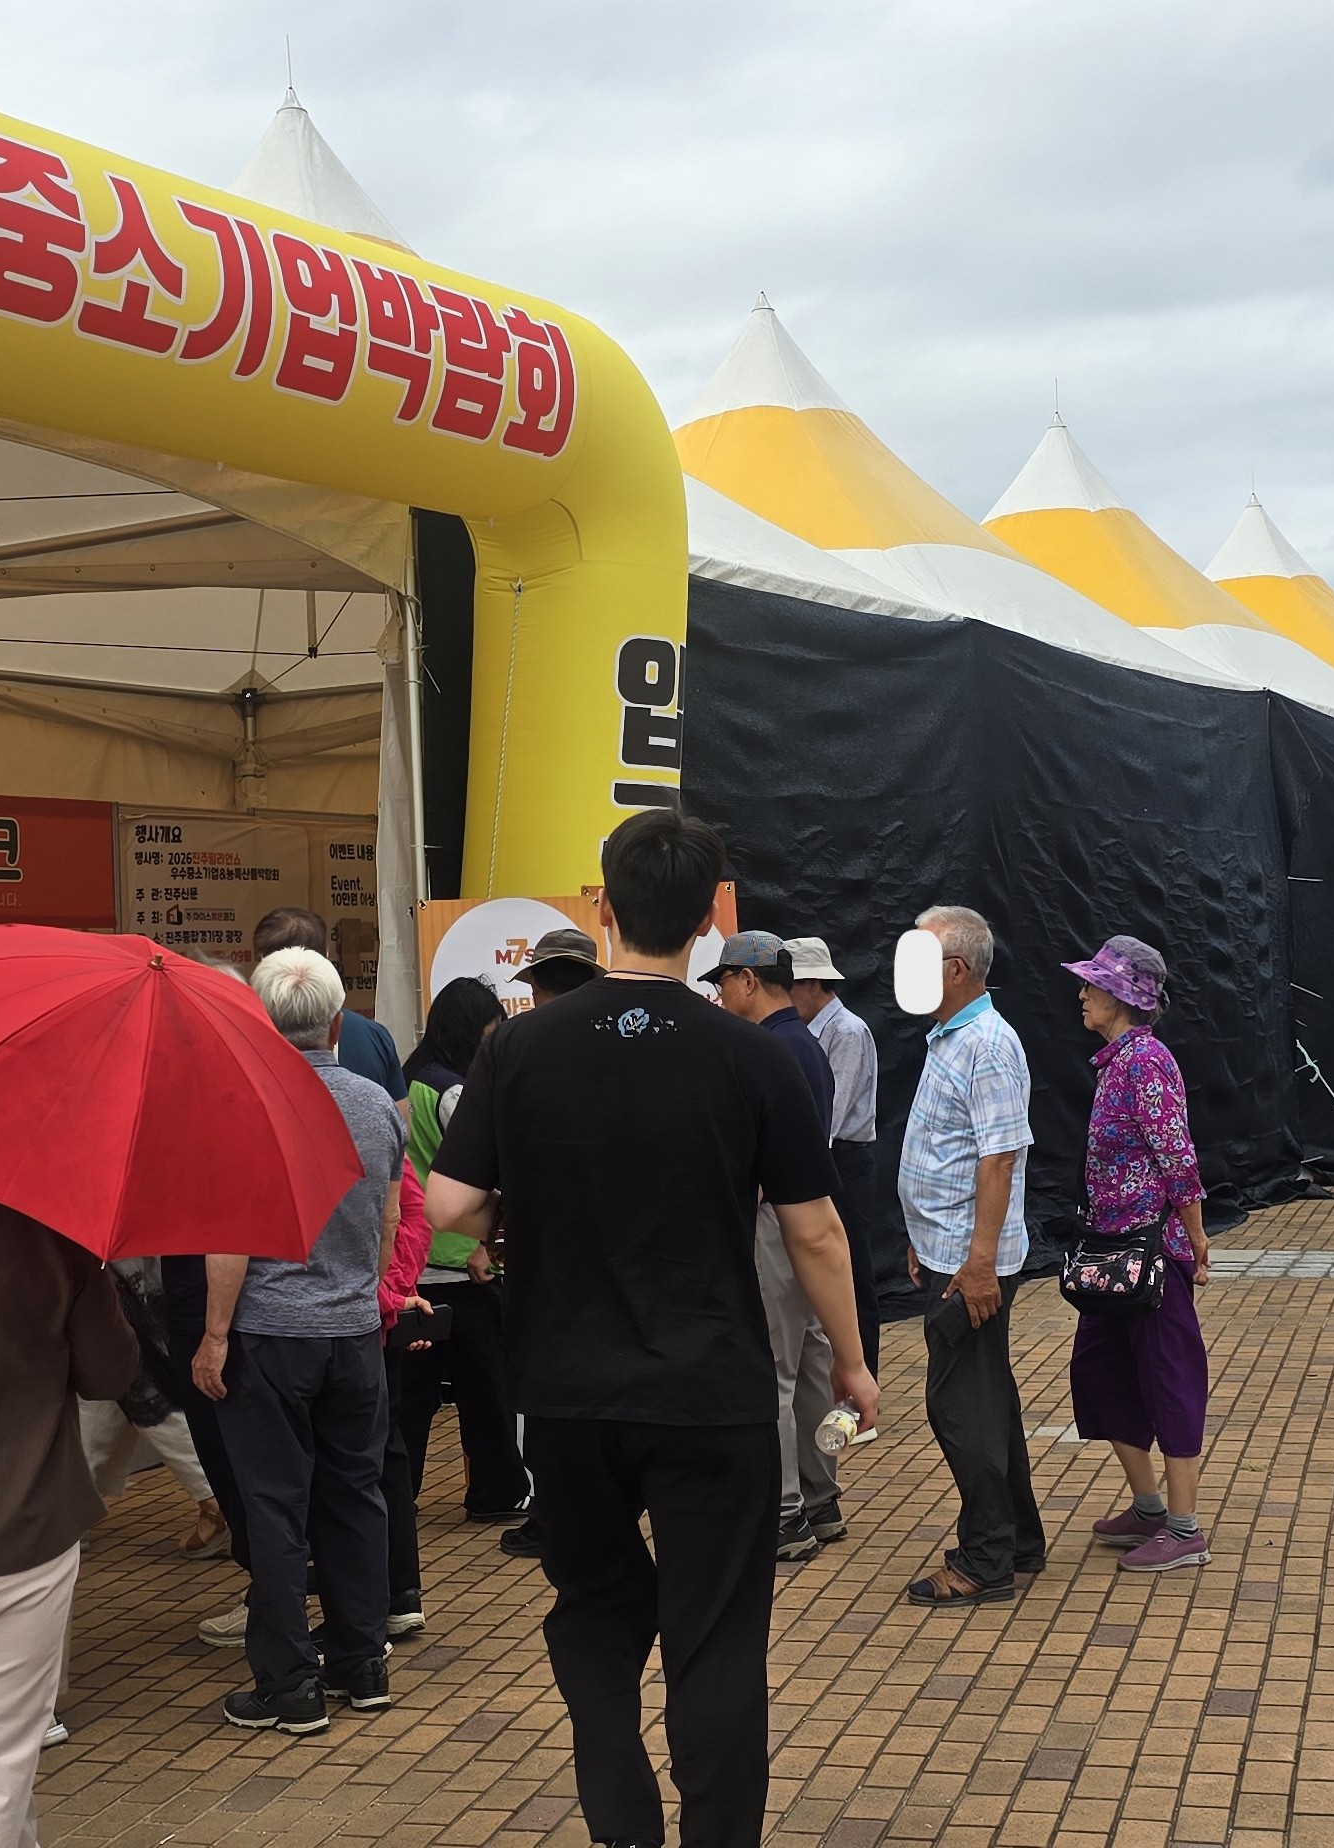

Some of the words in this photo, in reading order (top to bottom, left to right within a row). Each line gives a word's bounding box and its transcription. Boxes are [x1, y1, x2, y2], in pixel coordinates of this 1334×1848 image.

[134, 825, 182, 844] 행사개요
[134, 852, 164, 866] 행사명:
[331, 875, 363, 890] Event.
[164, 887, 198, 901] 진주신문
